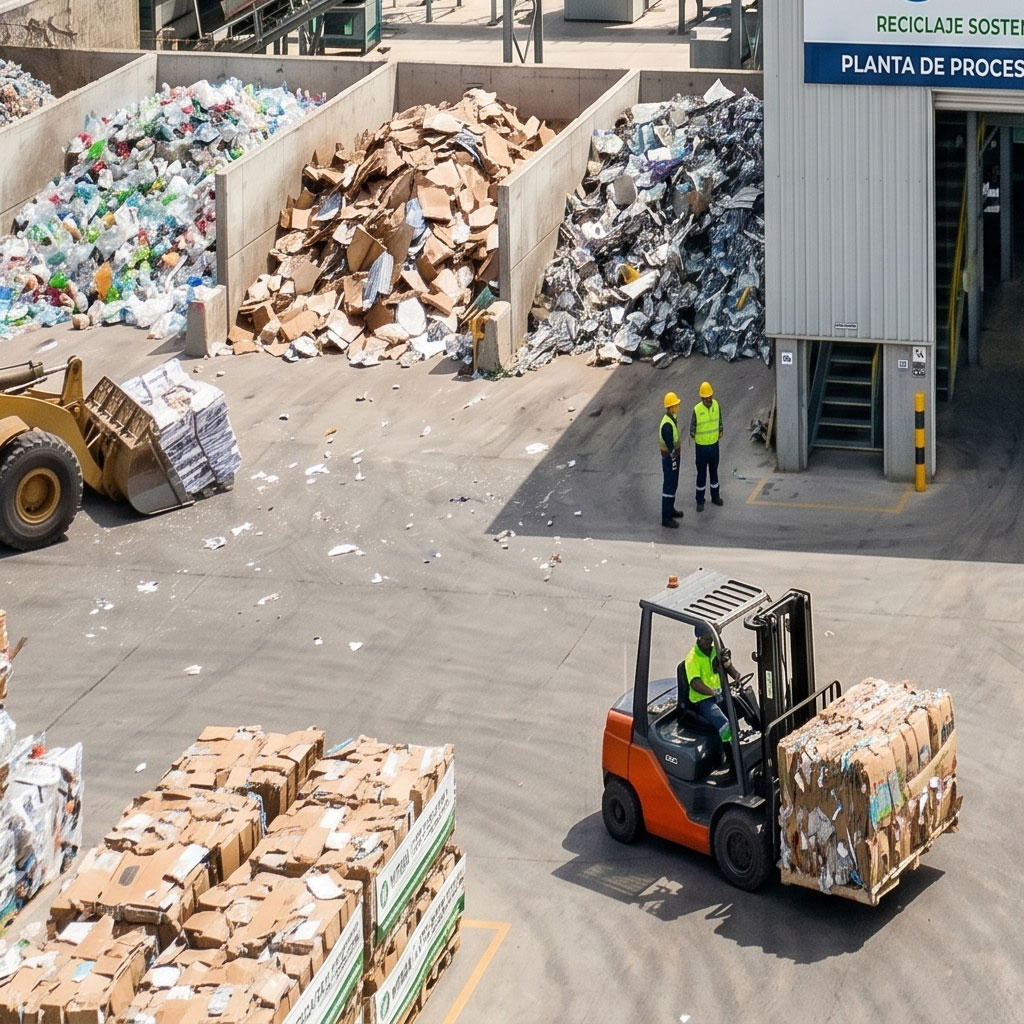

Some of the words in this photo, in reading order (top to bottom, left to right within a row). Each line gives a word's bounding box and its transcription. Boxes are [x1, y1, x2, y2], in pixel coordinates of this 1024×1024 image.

[876, 15, 963, 35] RECICLAJE
[841, 54, 916, 76] PLANTA
[920, 57, 945, 76] DE
